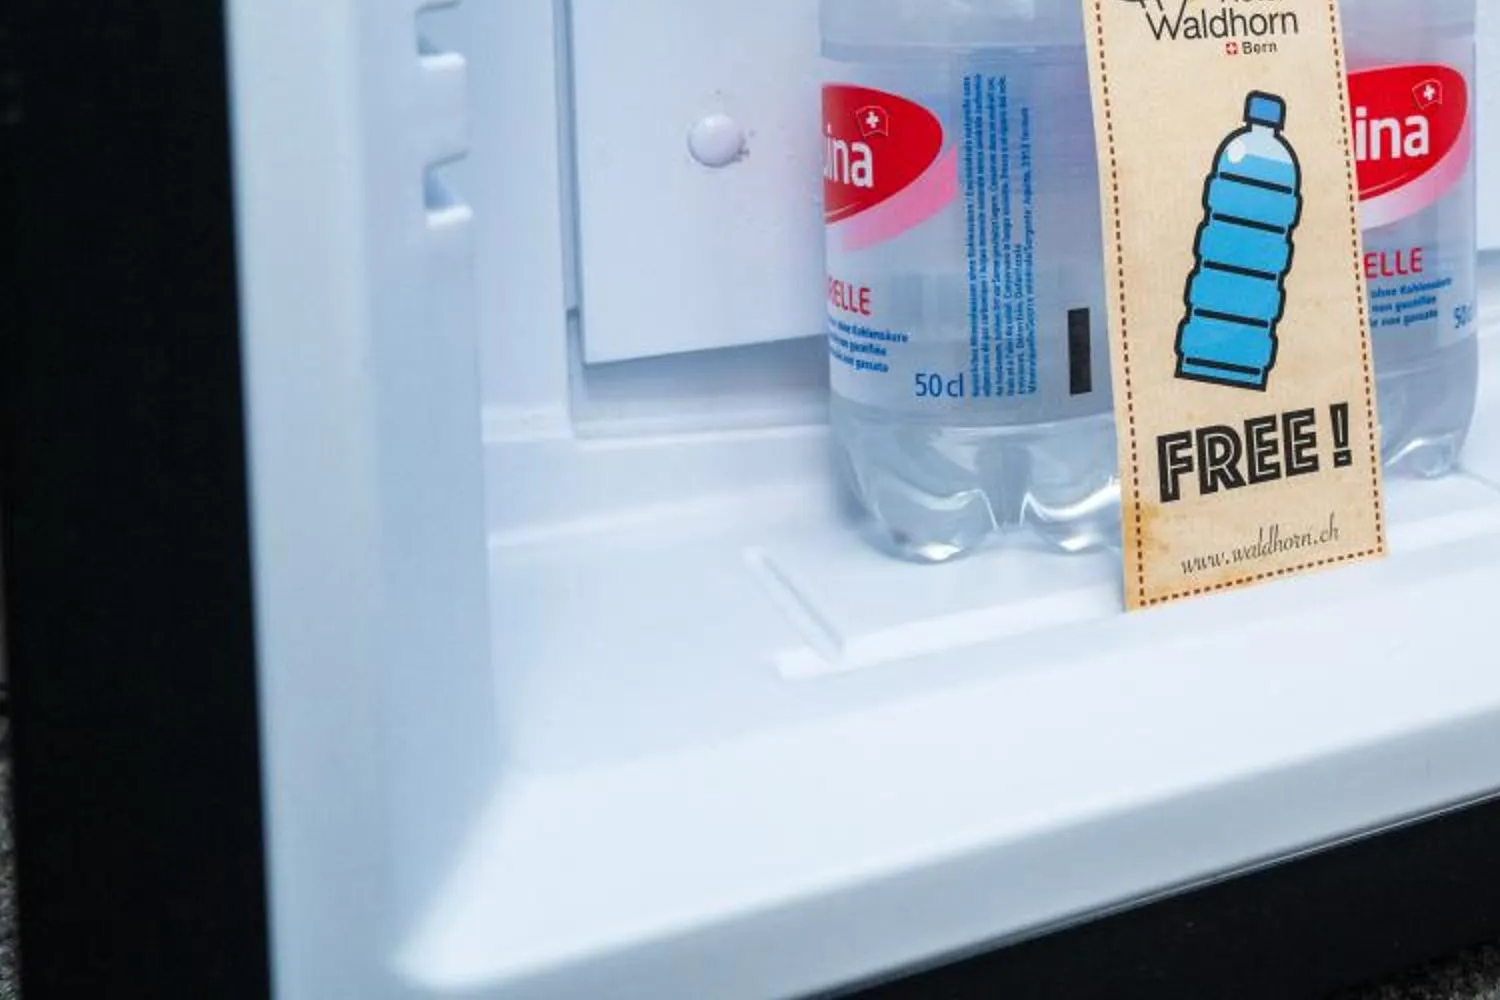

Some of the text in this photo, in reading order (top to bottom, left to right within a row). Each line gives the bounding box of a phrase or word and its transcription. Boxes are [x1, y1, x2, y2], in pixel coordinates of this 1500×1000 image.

[1242, 41, 1278, 55] Bern
[915, 372, 964, 398] 50 cl
[1181, 512, 1340, 575] www.waldhorn.ch
